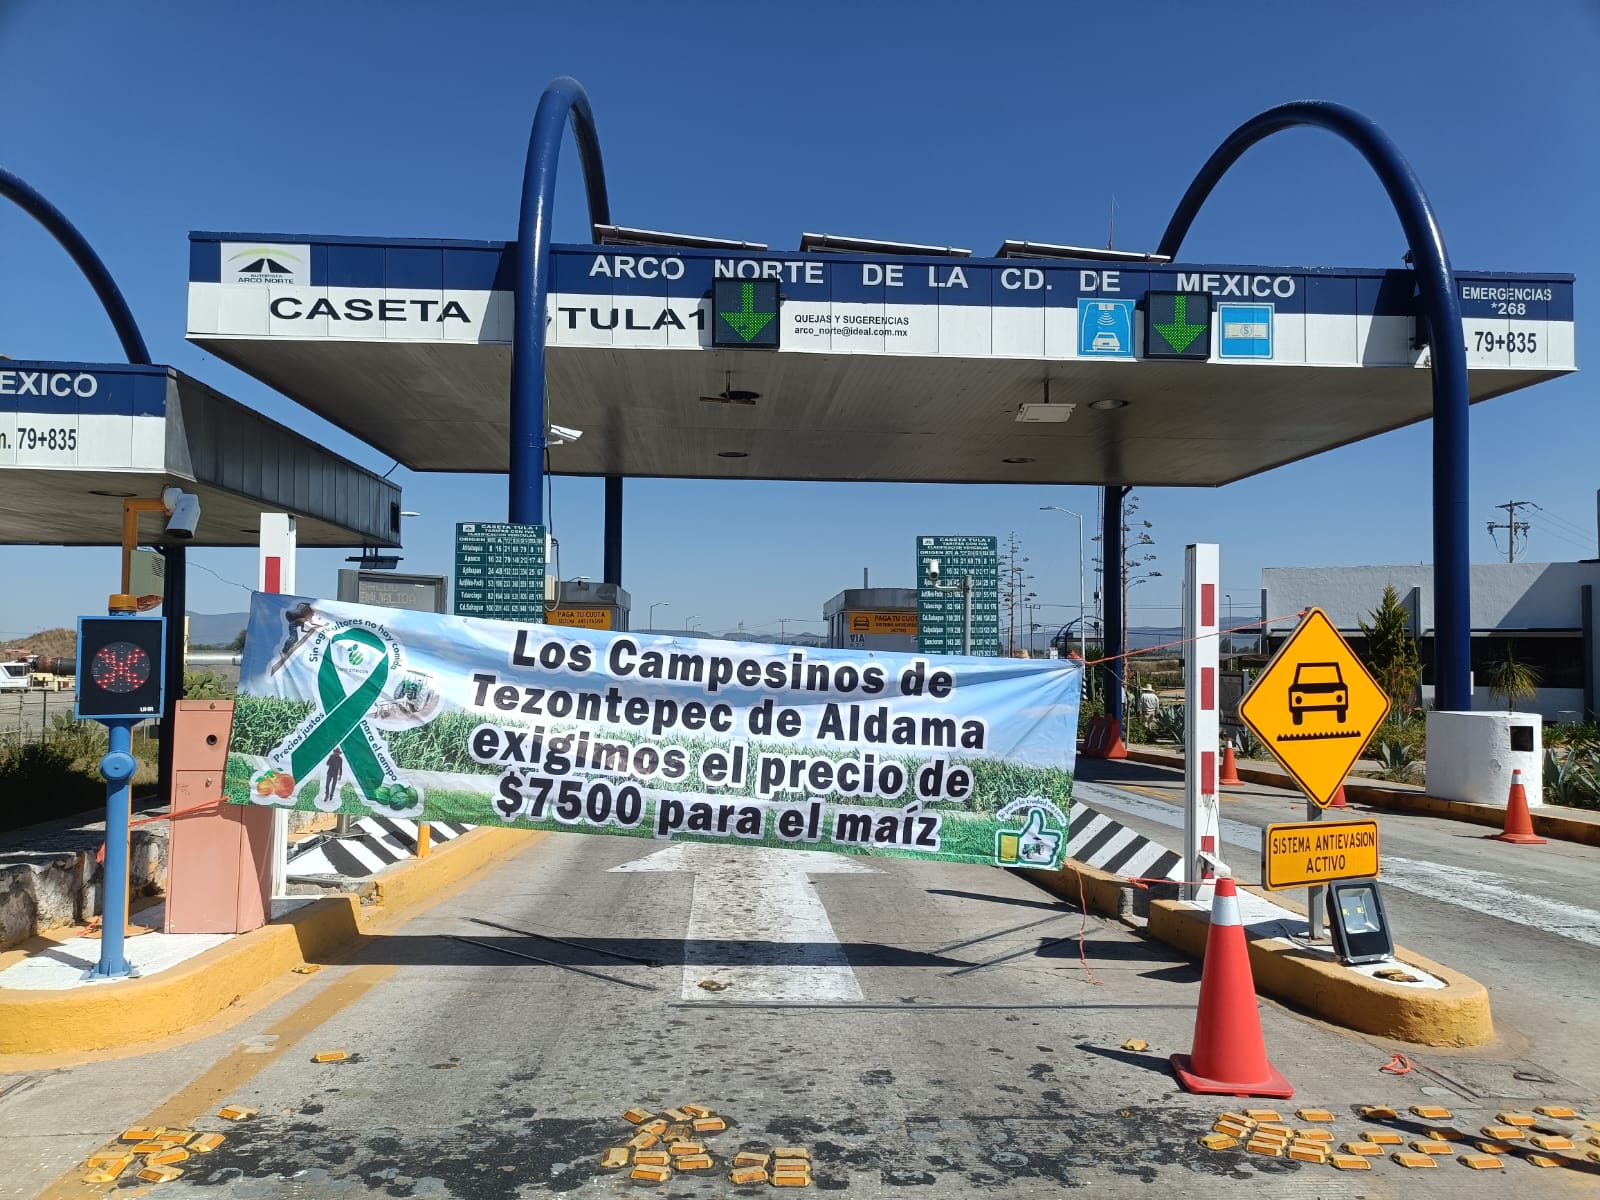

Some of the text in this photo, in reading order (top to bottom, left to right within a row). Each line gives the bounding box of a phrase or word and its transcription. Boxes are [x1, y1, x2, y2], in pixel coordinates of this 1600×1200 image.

[589, 255, 1296, 298] ARCO NORTE DE LA CD. DE MEXICO
[1462, 286, 1552, 301] EMERGENCIAS
[270, 297, 472, 323] CASETA
[794, 314, 909, 325] QUEJAS Y SUGERENCIAS
[794, 326, 908, 337] arco_norte@ideal.com.mx
[1474, 332, 1537, 353] 79+835
[18, 428, 76, 450] 79+835
[309, 619, 402, 670] Sin agrcultores no hay comida
[512, 630, 952, 698] Los Campesinos de
[473, 673, 985, 749] Tezontepec de Aldama
[273, 713, 324, 762] Precios justos
[360, 720, 397, 781] para el campo
[473, 725, 969, 798] exigimos el precio de
[496, 771, 937, 846] $7500 para el maíz
[1273, 832, 1374, 854] SISTEMA ANTIEVASION
[1306, 855, 1346, 873] ACTIVO
